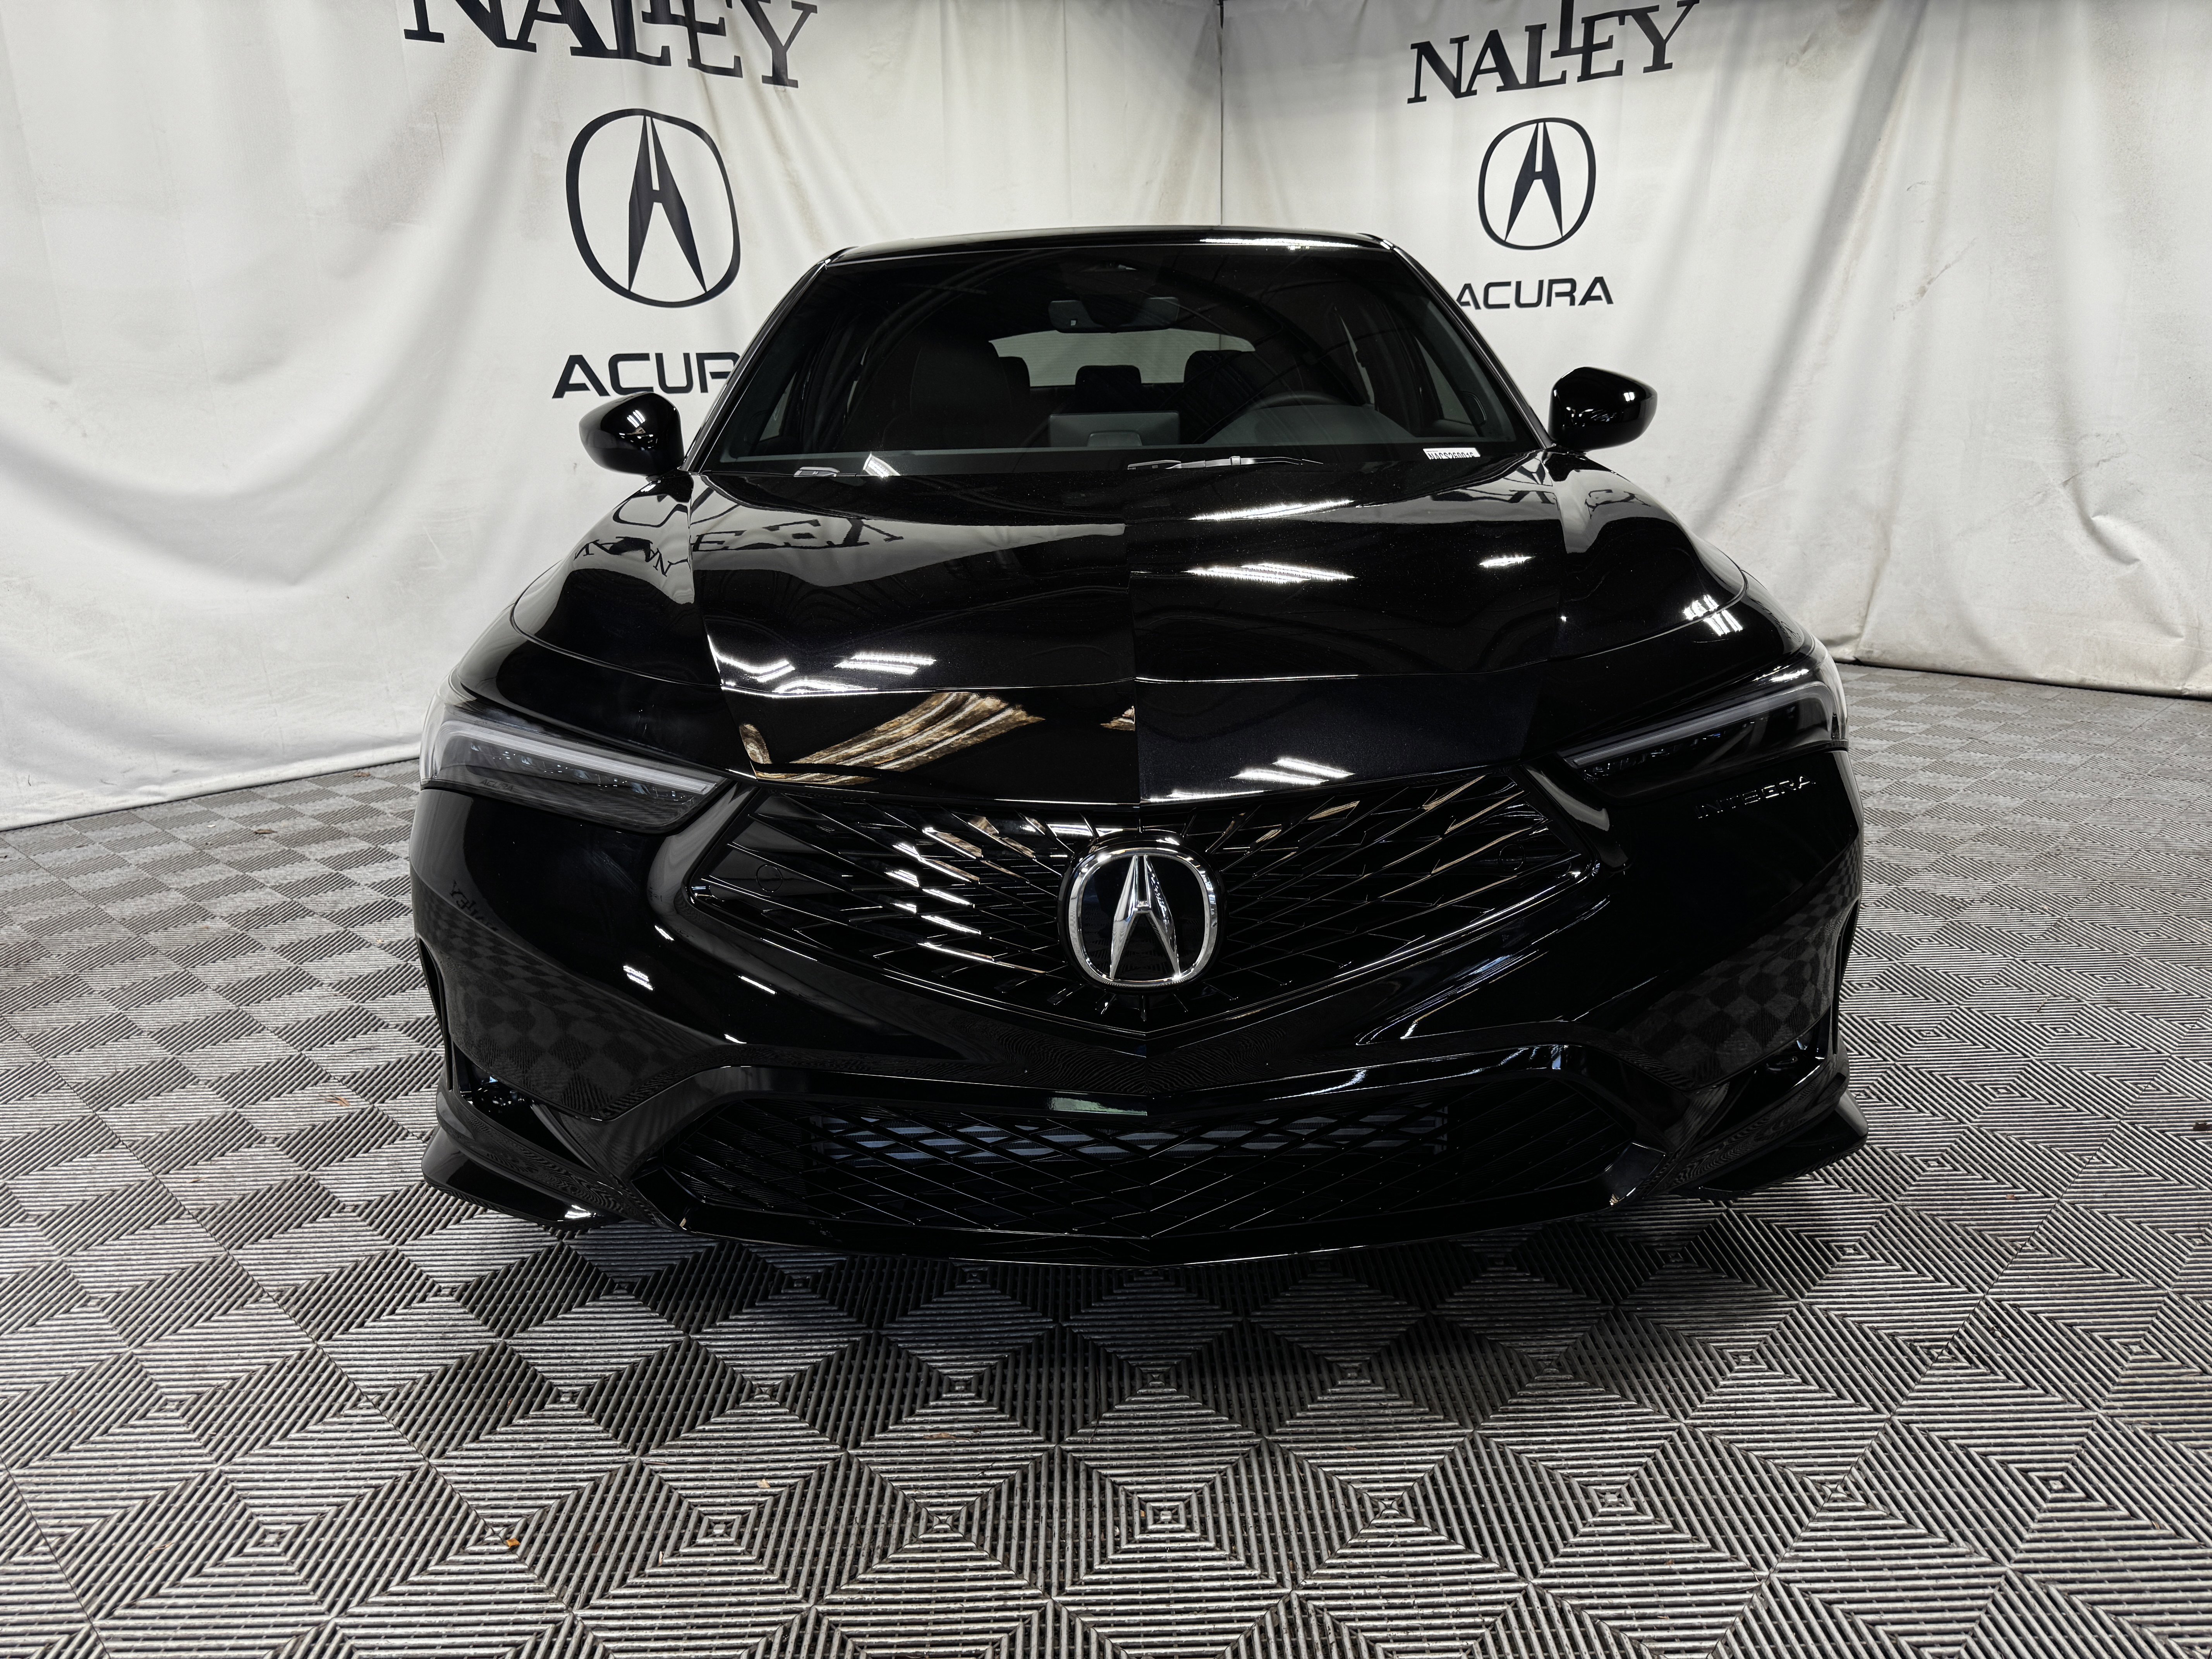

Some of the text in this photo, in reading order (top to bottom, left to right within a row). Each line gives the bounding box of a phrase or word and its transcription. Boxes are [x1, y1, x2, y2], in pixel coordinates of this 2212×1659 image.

[1407, 0, 1700, 104] NALLEY
[1456, 276, 1614, 310] ACURA
[1695, 775, 1816, 819] INTEGRA
